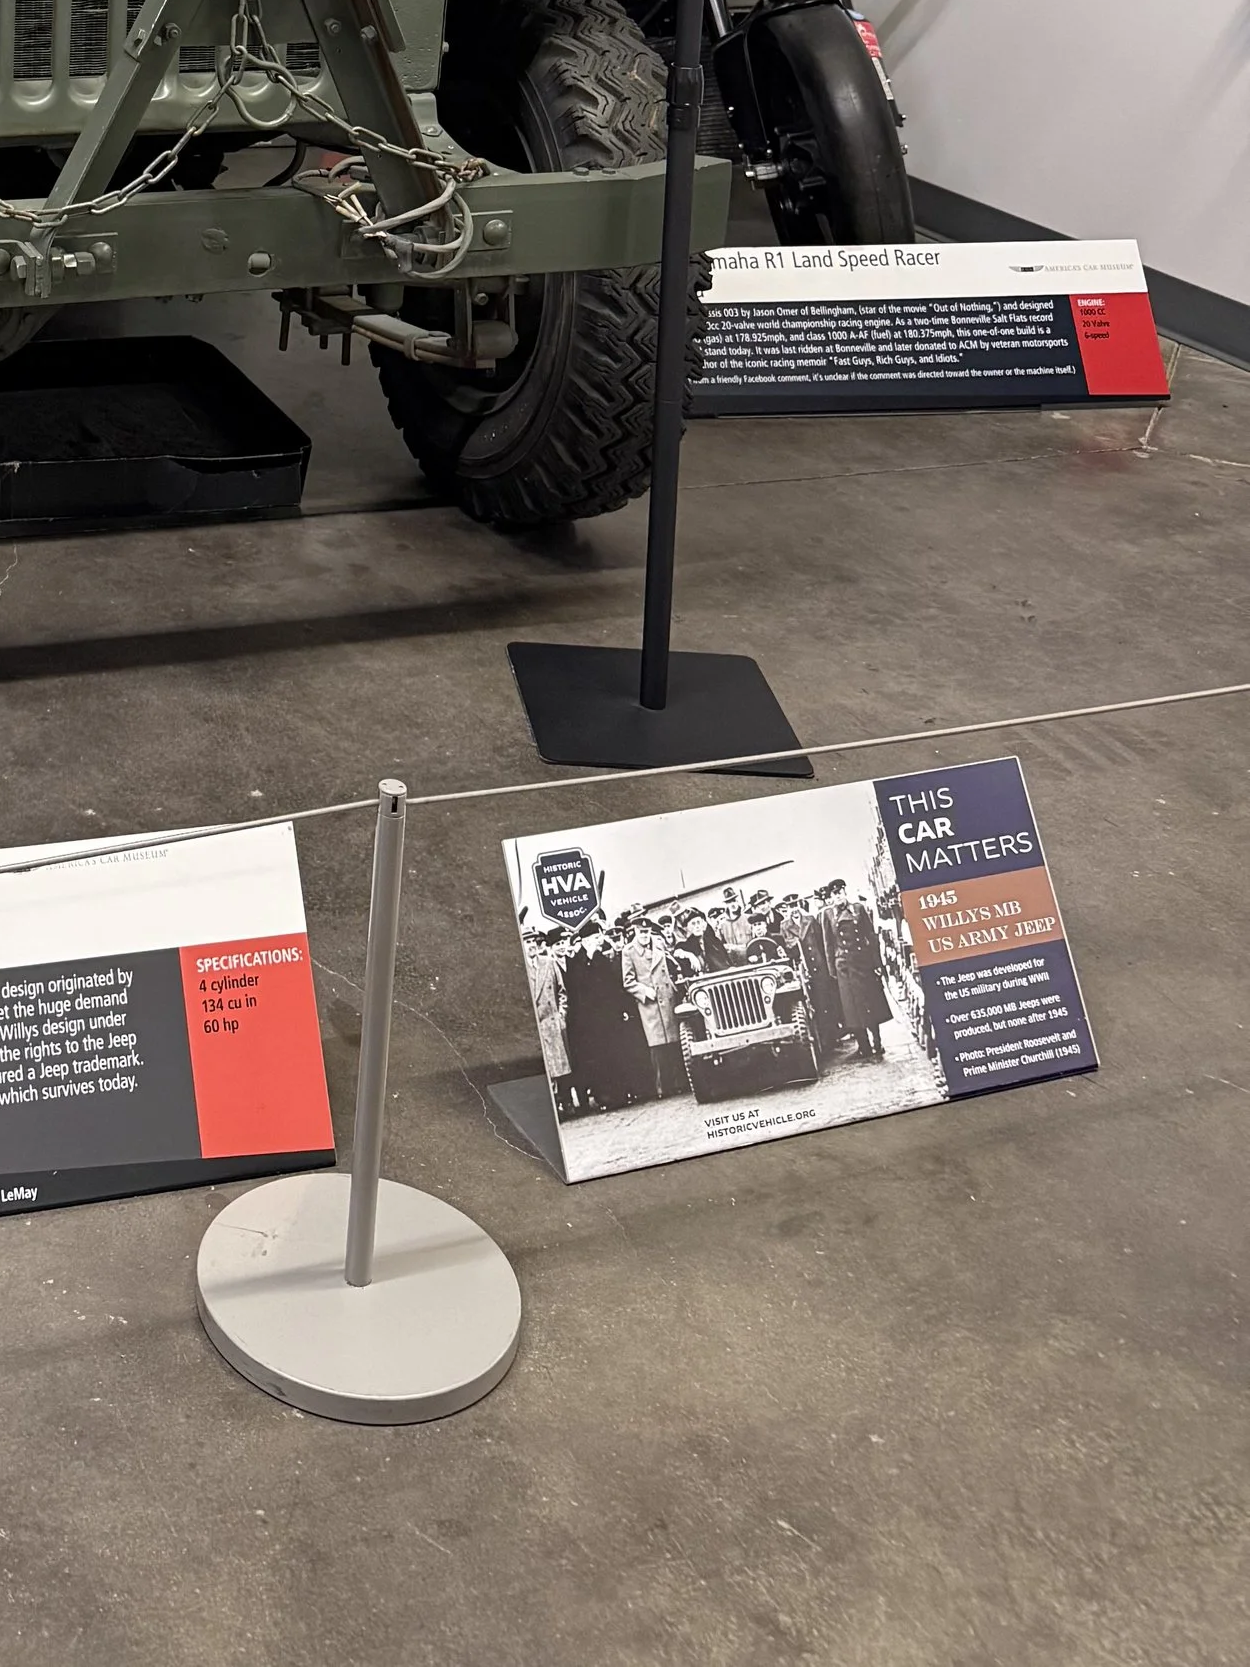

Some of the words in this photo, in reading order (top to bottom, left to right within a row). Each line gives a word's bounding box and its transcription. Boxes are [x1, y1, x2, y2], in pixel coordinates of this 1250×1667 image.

[1077, 299, 1105, 307] ENGINE:
[889, 787, 953, 816] THIS
[898, 817, 955, 844] CAR
[906, 832, 1033, 873] MATTERS
[543, 861, 581, 873] HISTORIC
[541, 872, 591, 896] HVA
[550, 894, 588, 906] VEHICLE
[919, 890, 958, 910] 1945
[556, 907, 590, 922] ASSOC.
[922, 906, 991, 931] WILLYS
[993, 901, 1022, 918] MB
[928, 937, 954, 953] US
[958, 925, 1008, 948] ARMY
[1015, 917, 1056, 937] JEEP
[196, 947, 303, 973] SPECIFICATIONS:
[940, 976, 956, 986] The
[957, 972, 976, 983] Jeep
[976, 969, 992, 979] was
[993, 959, 1033, 976] developed
[1033, 958, 1045, 967] for
[1, 980, 44, 1002] design
[48, 968, 114, 995] originated
[117, 968, 133, 990] by
[199, 980, 207, 992] 4
[211, 973, 259, 994] cylinder
[944, 991, 958, 1001] the
[958, 987, 970, 998] US
[970, 982, 1001, 995] military
[1002, 977, 1028, 989] during
[1027, 972, 1050, 983] WWII
[202, 998, 224, 1013] 134
[228, 998, 242, 1010] cu
[245, 994, 257, 1008] in
[950, 1013, 969, 1024] Over
[970, 1005, 1003, 1019] 635,000
[1003, 1002, 1017, 1013] MB
[1018, 999, 1040, 1010] Jeeps
[1040, 995, 1061, 1005] were
[204, 1019, 220, 1033] 60
[223, 1017, 239, 1034] hp
[954, 1022, 993, 1040] produced,
[992, 1020, 1007, 1030] but
[1007, 1017, 1027, 1027] none
[1028, 1012, 1046, 1023] after
[1048, 1007, 1068, 1019] 1945
[959, 1050, 986, 1062] Photo:
[985, 1041, 1023, 1056] President
[1023, 1033, 1061, 1048] Roosevelt
[1061, 1029, 1077, 1040] and
[963, 1065, 987, 1077] Prime
[987, 1058, 1019, 1072] Minister
[1020, 1049, 1055, 1065] Churchill
[1055, 1044, 1081, 1058] (1945)
[704, 1115, 729, 1127] VISIT
[732, 1112, 745, 1122] US
[748, 1109, 759, 1118] AT
[707, 1109, 816, 1139] HISTORICVEHICLE.ORG
[1, 1187, 37, 1202] LeMay
